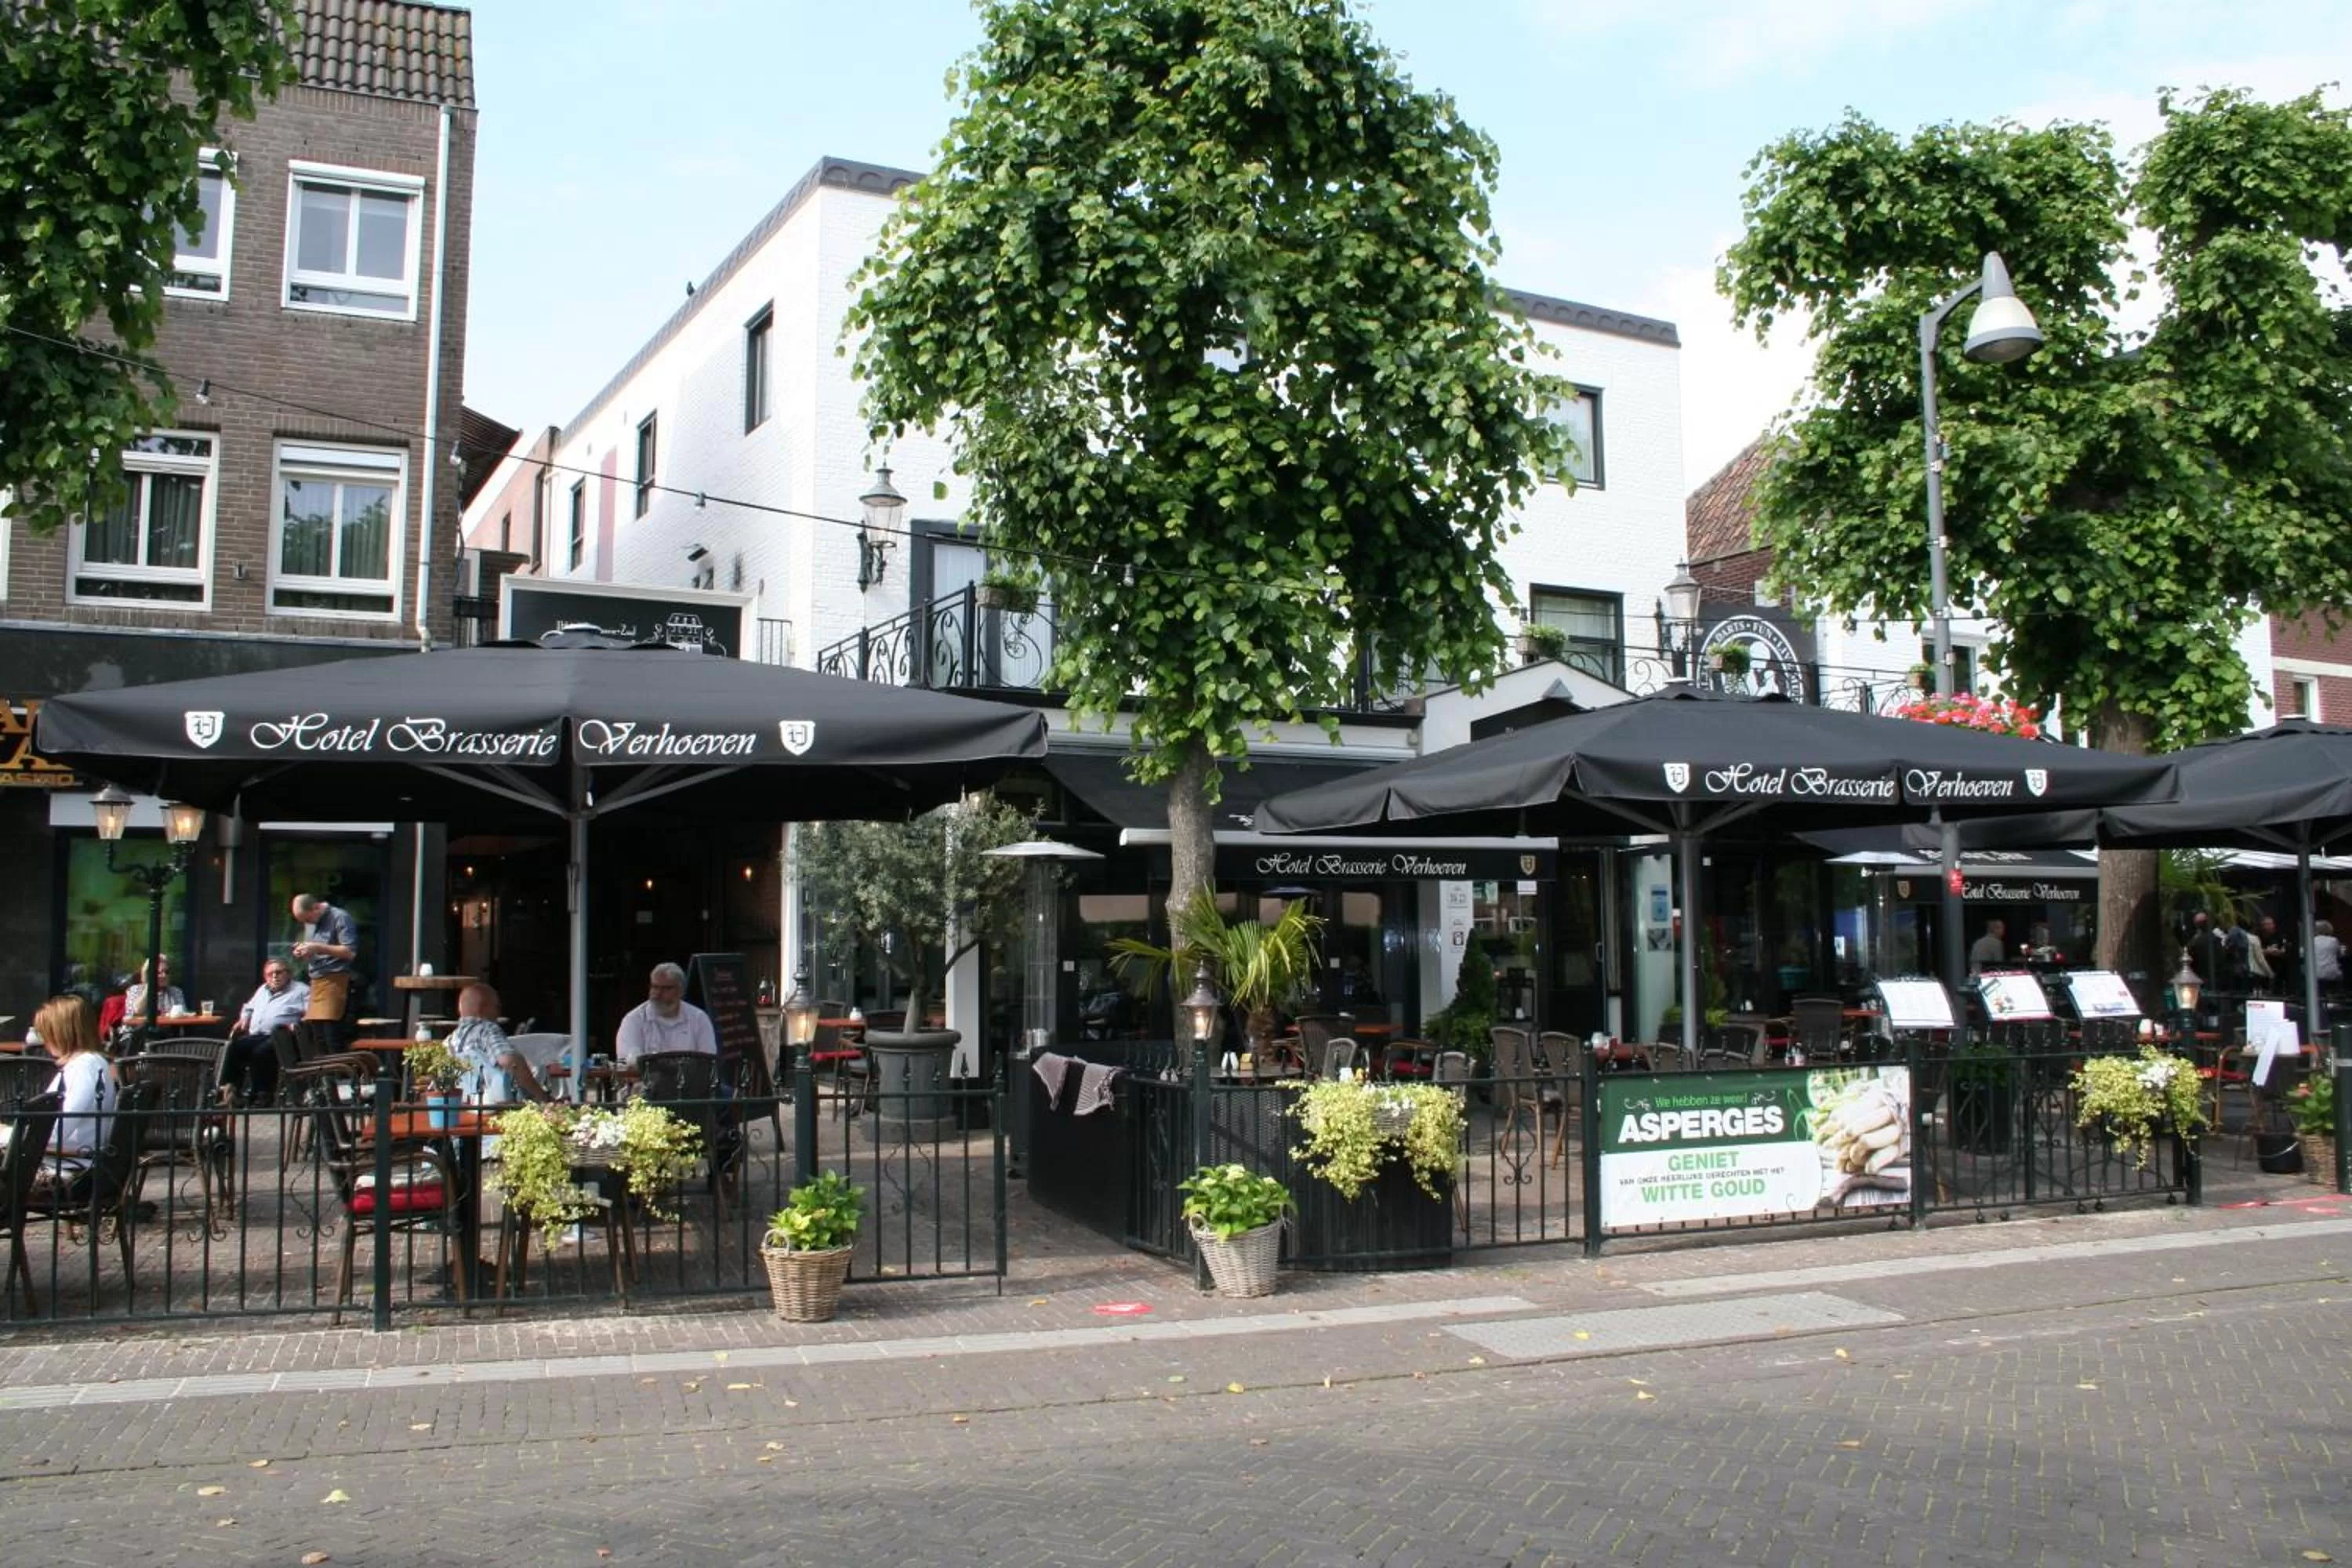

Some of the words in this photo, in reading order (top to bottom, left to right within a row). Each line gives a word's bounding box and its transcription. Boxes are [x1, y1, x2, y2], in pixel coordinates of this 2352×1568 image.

[1752, 622, 1773, 638] FUN
[250, 713, 380, 752] Hotel
[387, 716, 557, 757] Brasserie
[579, 719, 757, 755] Verhoeven
[1705, 762, 1786, 794] Hotel
[1791, 767, 1895, 797] Brasserie
[1905, 769, 2013, 797] Verhoeven
[1256, 852, 1312, 874] Hotel
[1316, 854, 1387, 875] Brasserie
[1392, 854, 1467, 875] Verhoeven
[1654, 1095, 1671, 1108] We
[1617, 1105, 1784, 1144] ASPERGES
[1668, 1150, 1740, 1172] GENIET
[1637, 1176, 1658, 1185] ONZE
[1640, 1182, 1704, 1203] WITTE
[1710, 1178, 1766, 1198] GOUD
